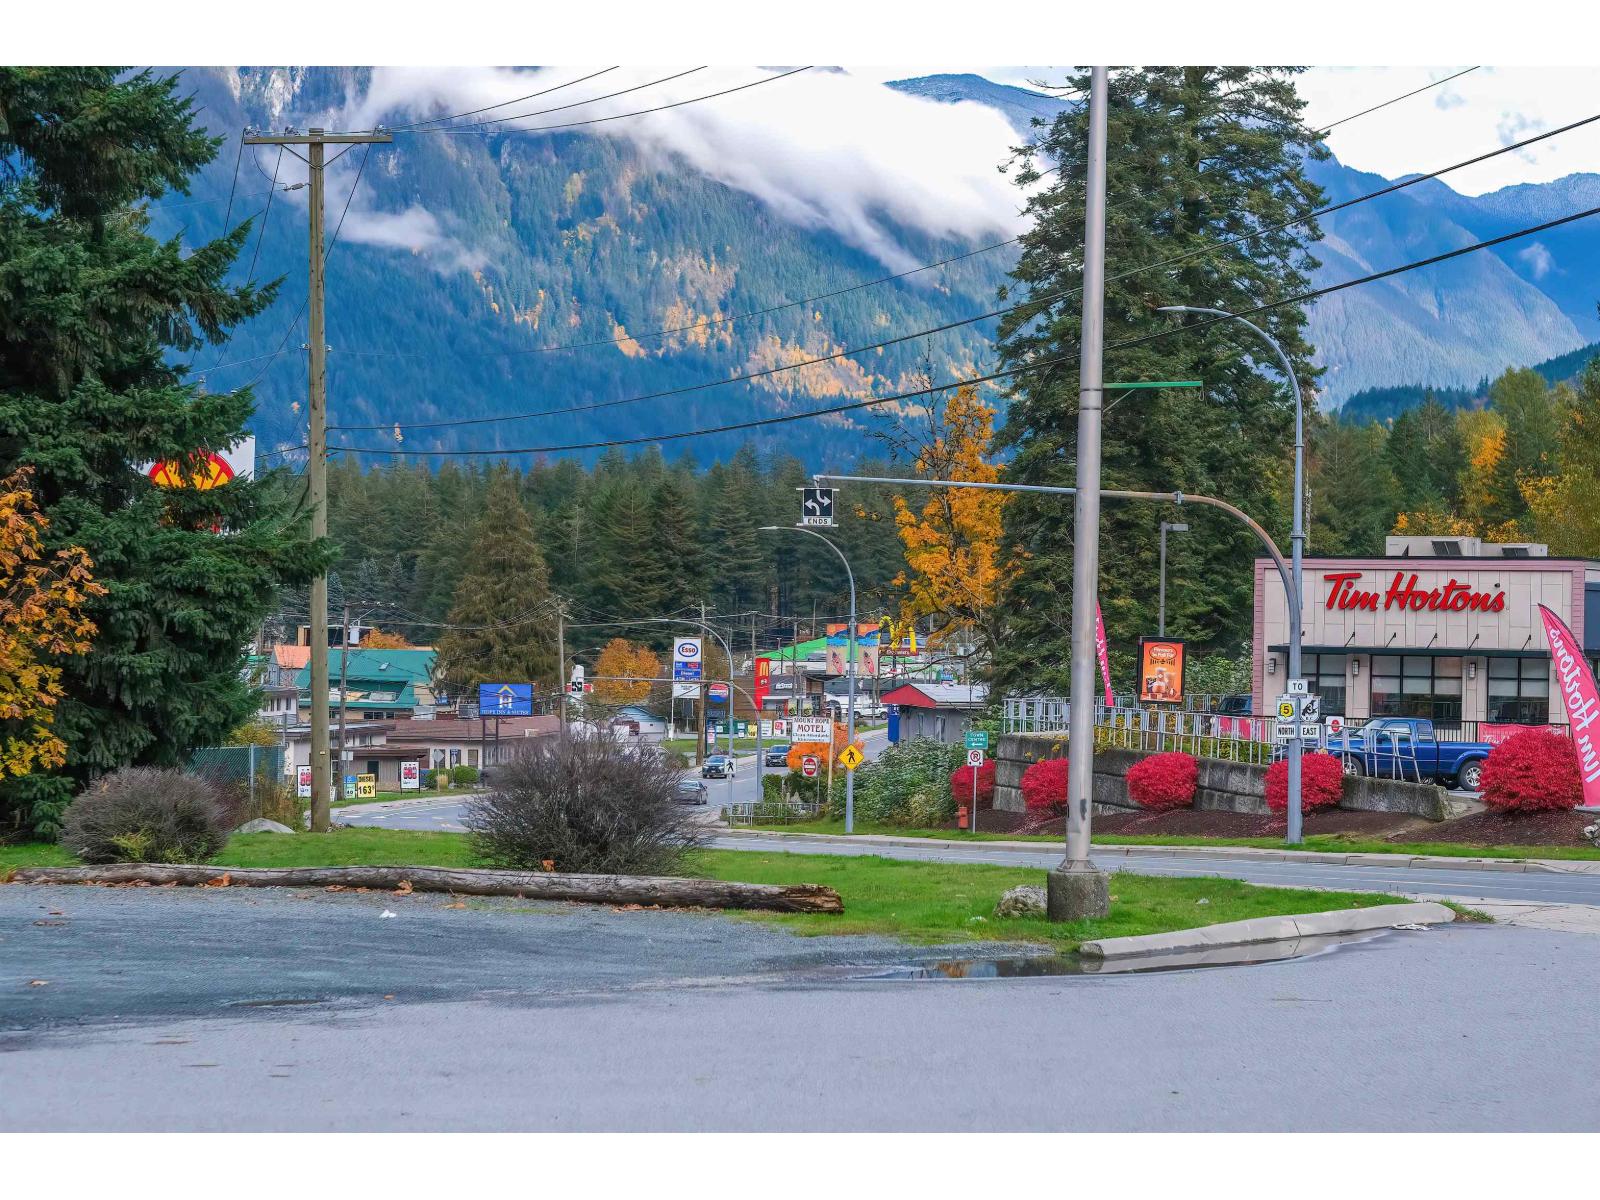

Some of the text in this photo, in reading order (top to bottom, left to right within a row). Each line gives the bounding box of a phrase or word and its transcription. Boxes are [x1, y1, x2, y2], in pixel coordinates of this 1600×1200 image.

[1324, 571, 1505, 613] Tim Hortons
[1293, 682, 1303, 690] TO
[1283, 705, 1290, 714] 5
[1306, 703, 1313, 714] 3
[797, 724, 826, 732] MOTEL
[1278, 727, 1295, 736] NORTH
[1303, 727, 1317, 736] EAST
